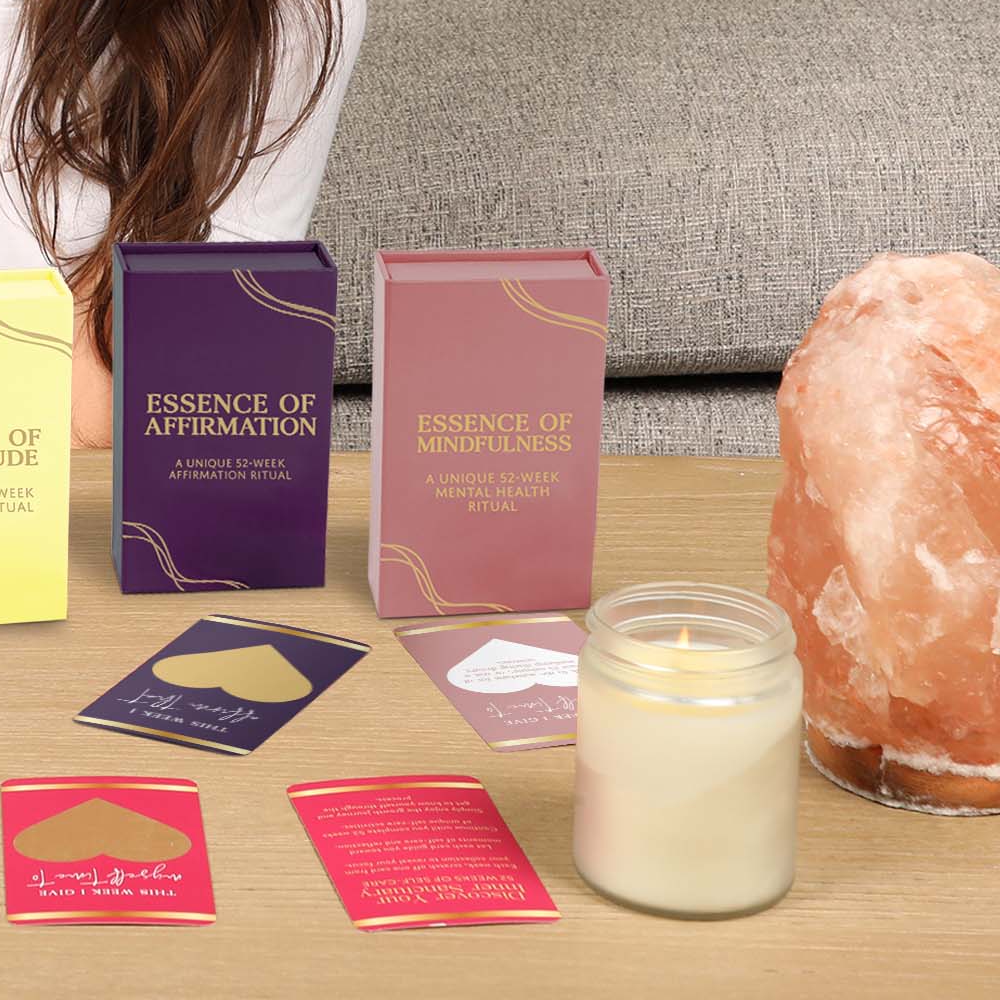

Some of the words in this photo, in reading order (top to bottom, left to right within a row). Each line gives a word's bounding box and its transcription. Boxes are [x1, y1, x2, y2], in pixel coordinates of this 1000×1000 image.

[146, 392, 268, 414] ESSENCE
[279, 392, 317, 414] OF
[144, 416, 317, 436] AFFIRMATION
[417, 413, 529, 433] ESSENCE
[539, 412, 573, 432] OF
[8, 428, 42, 447] OF
[417, 434, 572, 453] MINDFULNESS
[175, 459, 183, 468] A
[186, 458, 232, 469] UNIQUE
[235, 458, 286, 469] 52-WEEK
[168, 470, 246, 480] AFFIRMATION
[250, 470, 292, 480] RITUAL
[425, 474, 435, 484] A
[439, 473, 495, 485] UNIQUE
[499, 472, 560, 484] 52-WEEK
[435, 487, 491, 499] MENTAL
[496, 486, 550, 498] HEALTH
[468, 500, 519, 512] RITUAL
[142, 710, 185, 725] WEEK
[503, 716, 540, 727] GIVE
[190, 721, 228, 734] THIS
[434, 875, 453, 883] OF
[454, 875, 499, 883] WEEKS
[39, 889, 76, 897] GIVE
[91, 889, 134, 897] WEEK
[140, 889, 177, 897] THIS
